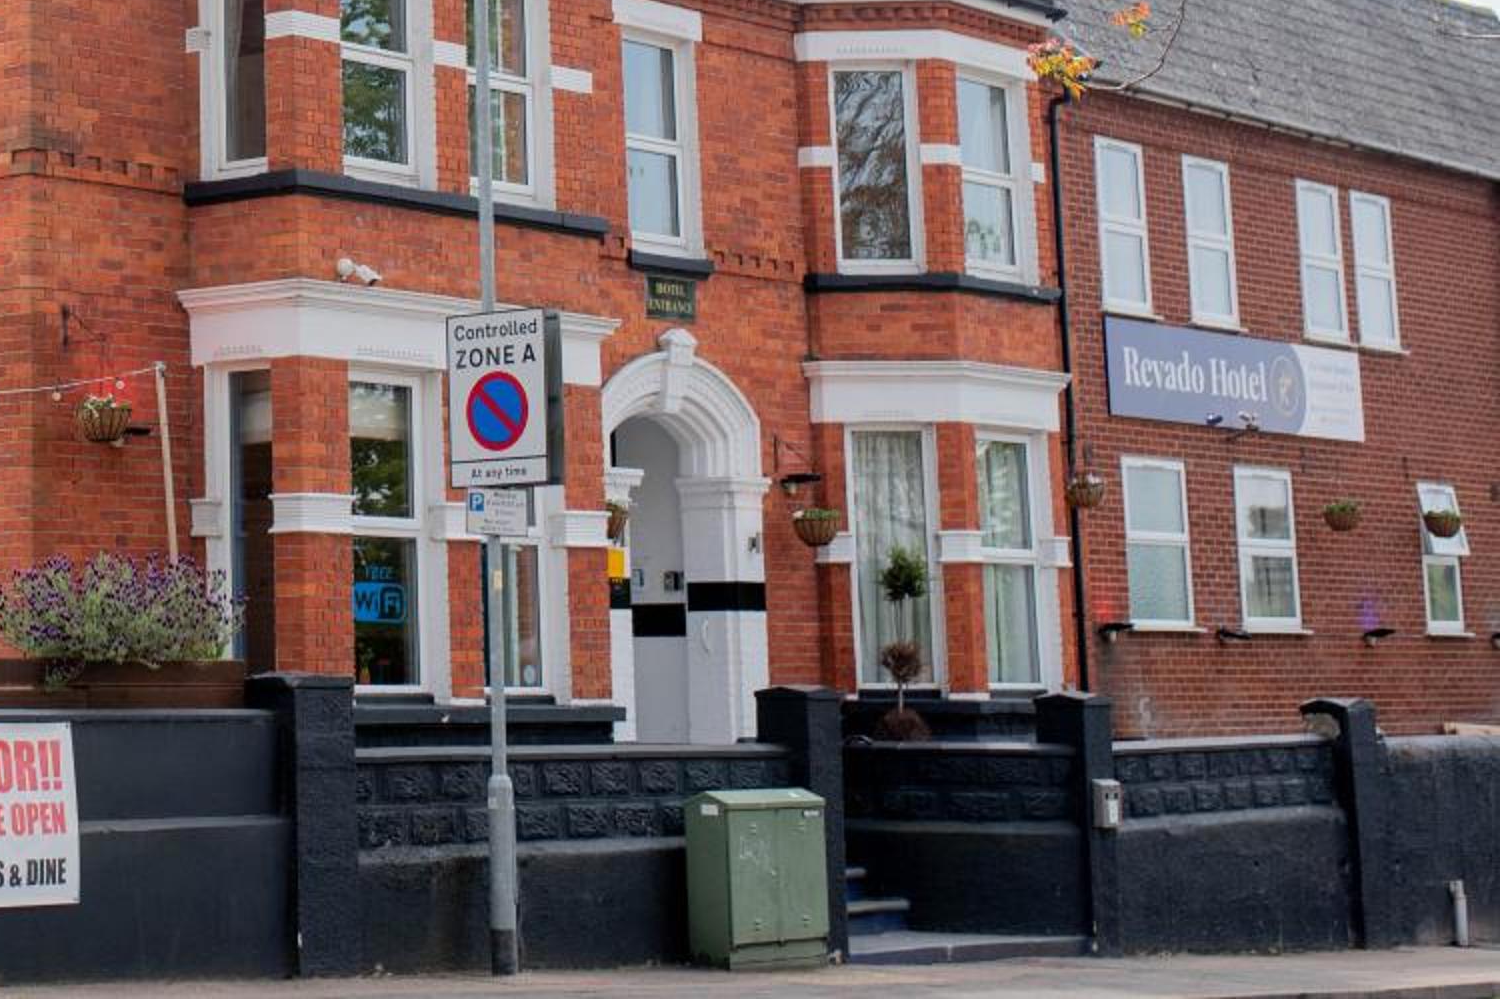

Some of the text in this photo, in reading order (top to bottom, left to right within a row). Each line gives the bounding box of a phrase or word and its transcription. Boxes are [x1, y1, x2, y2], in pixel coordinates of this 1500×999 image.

[453, 318, 538, 342] Controlled
[455, 343, 536, 370] ZONE A
[1123, 346, 1205, 394] Revado
[1209, 358, 1268, 401] Hotel
[471, 468, 482, 478] At
[505, 464, 527, 476] time
[10, 802, 67, 836] OPEN
[9, 865, 23, 887] &
[26, 858, 67, 886] DINE
